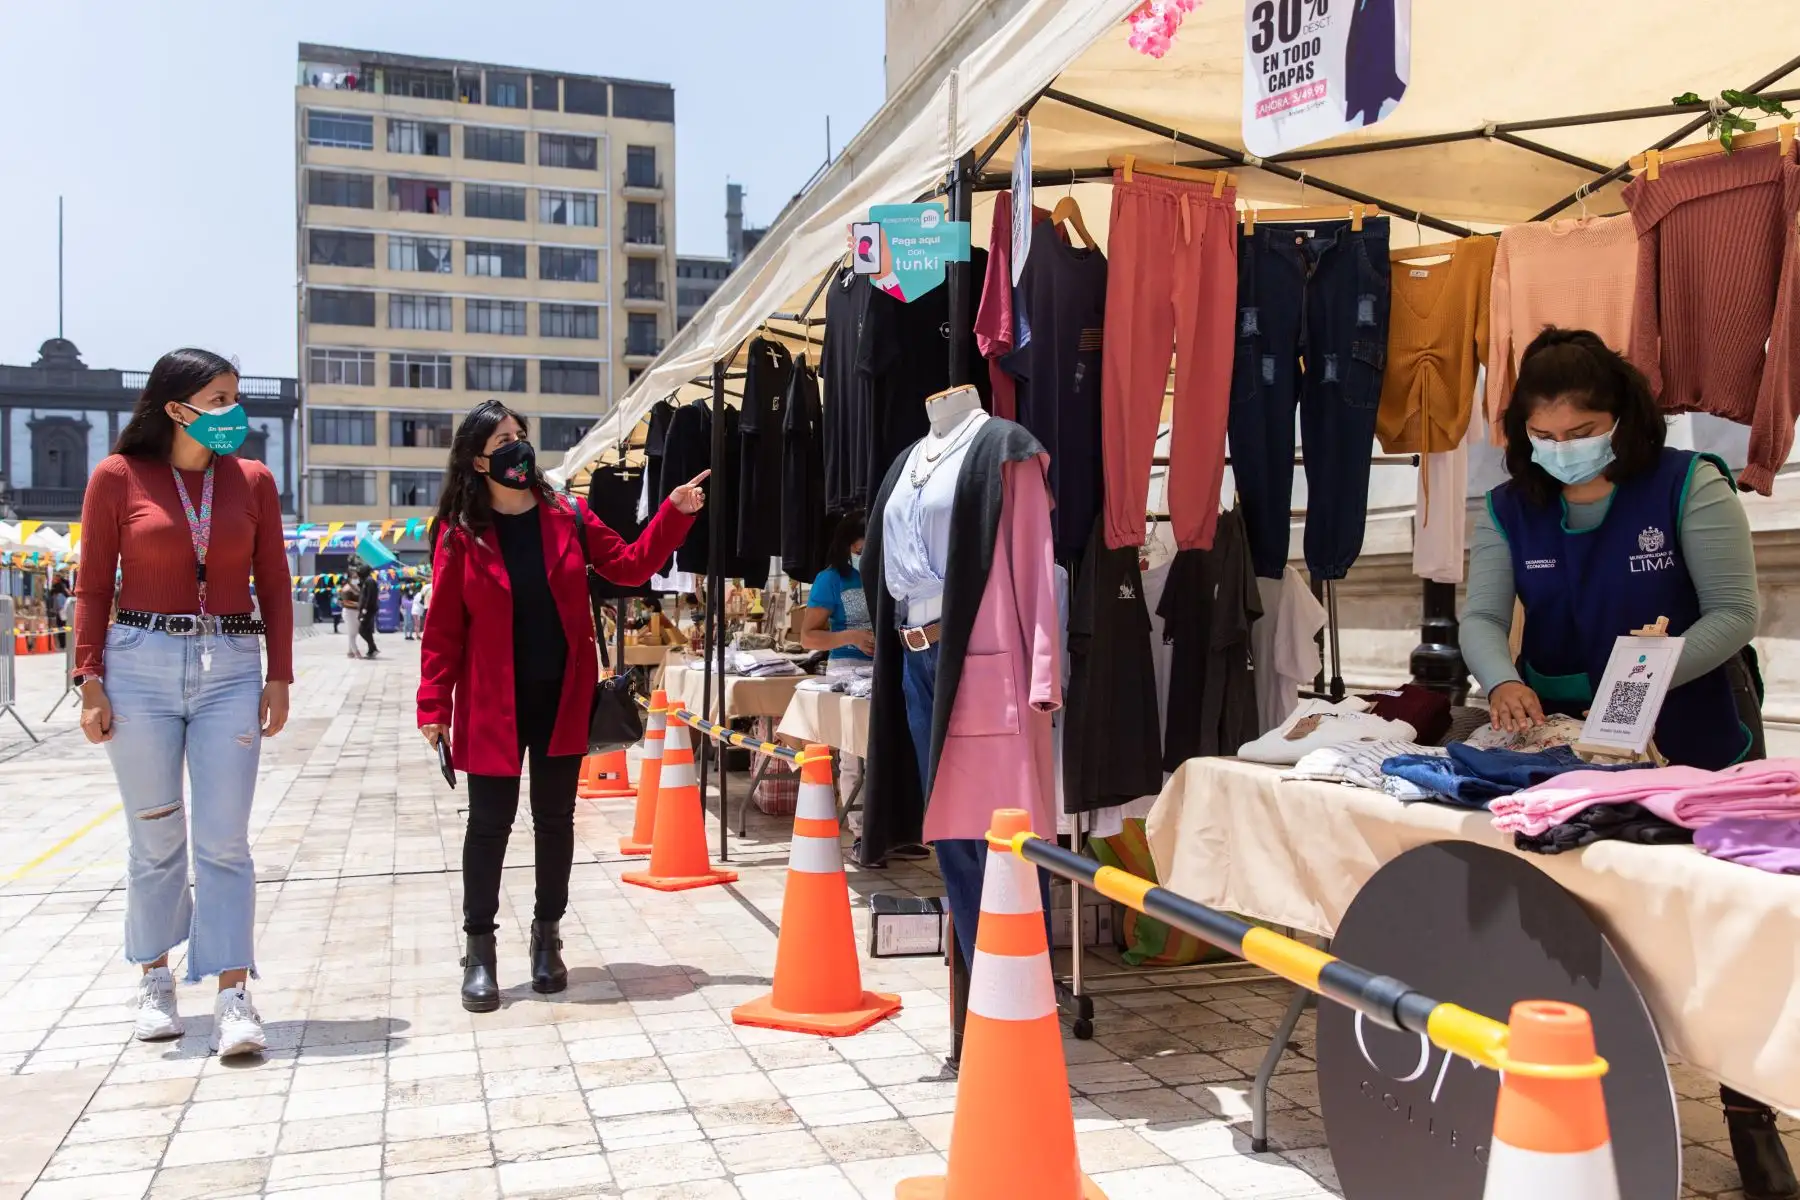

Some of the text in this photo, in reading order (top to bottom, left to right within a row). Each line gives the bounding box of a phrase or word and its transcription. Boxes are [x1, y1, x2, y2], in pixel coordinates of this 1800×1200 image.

[1263, 36, 1321, 74] EN TODO
[1268, 61, 1315, 93] CAPAS
[891, 237, 917, 247] Paga
[895, 256, 938, 272] tunki
[1629, 552, 1667, 560] MUNICIPALIDAD
[1630, 556, 1675, 573] LIMA
